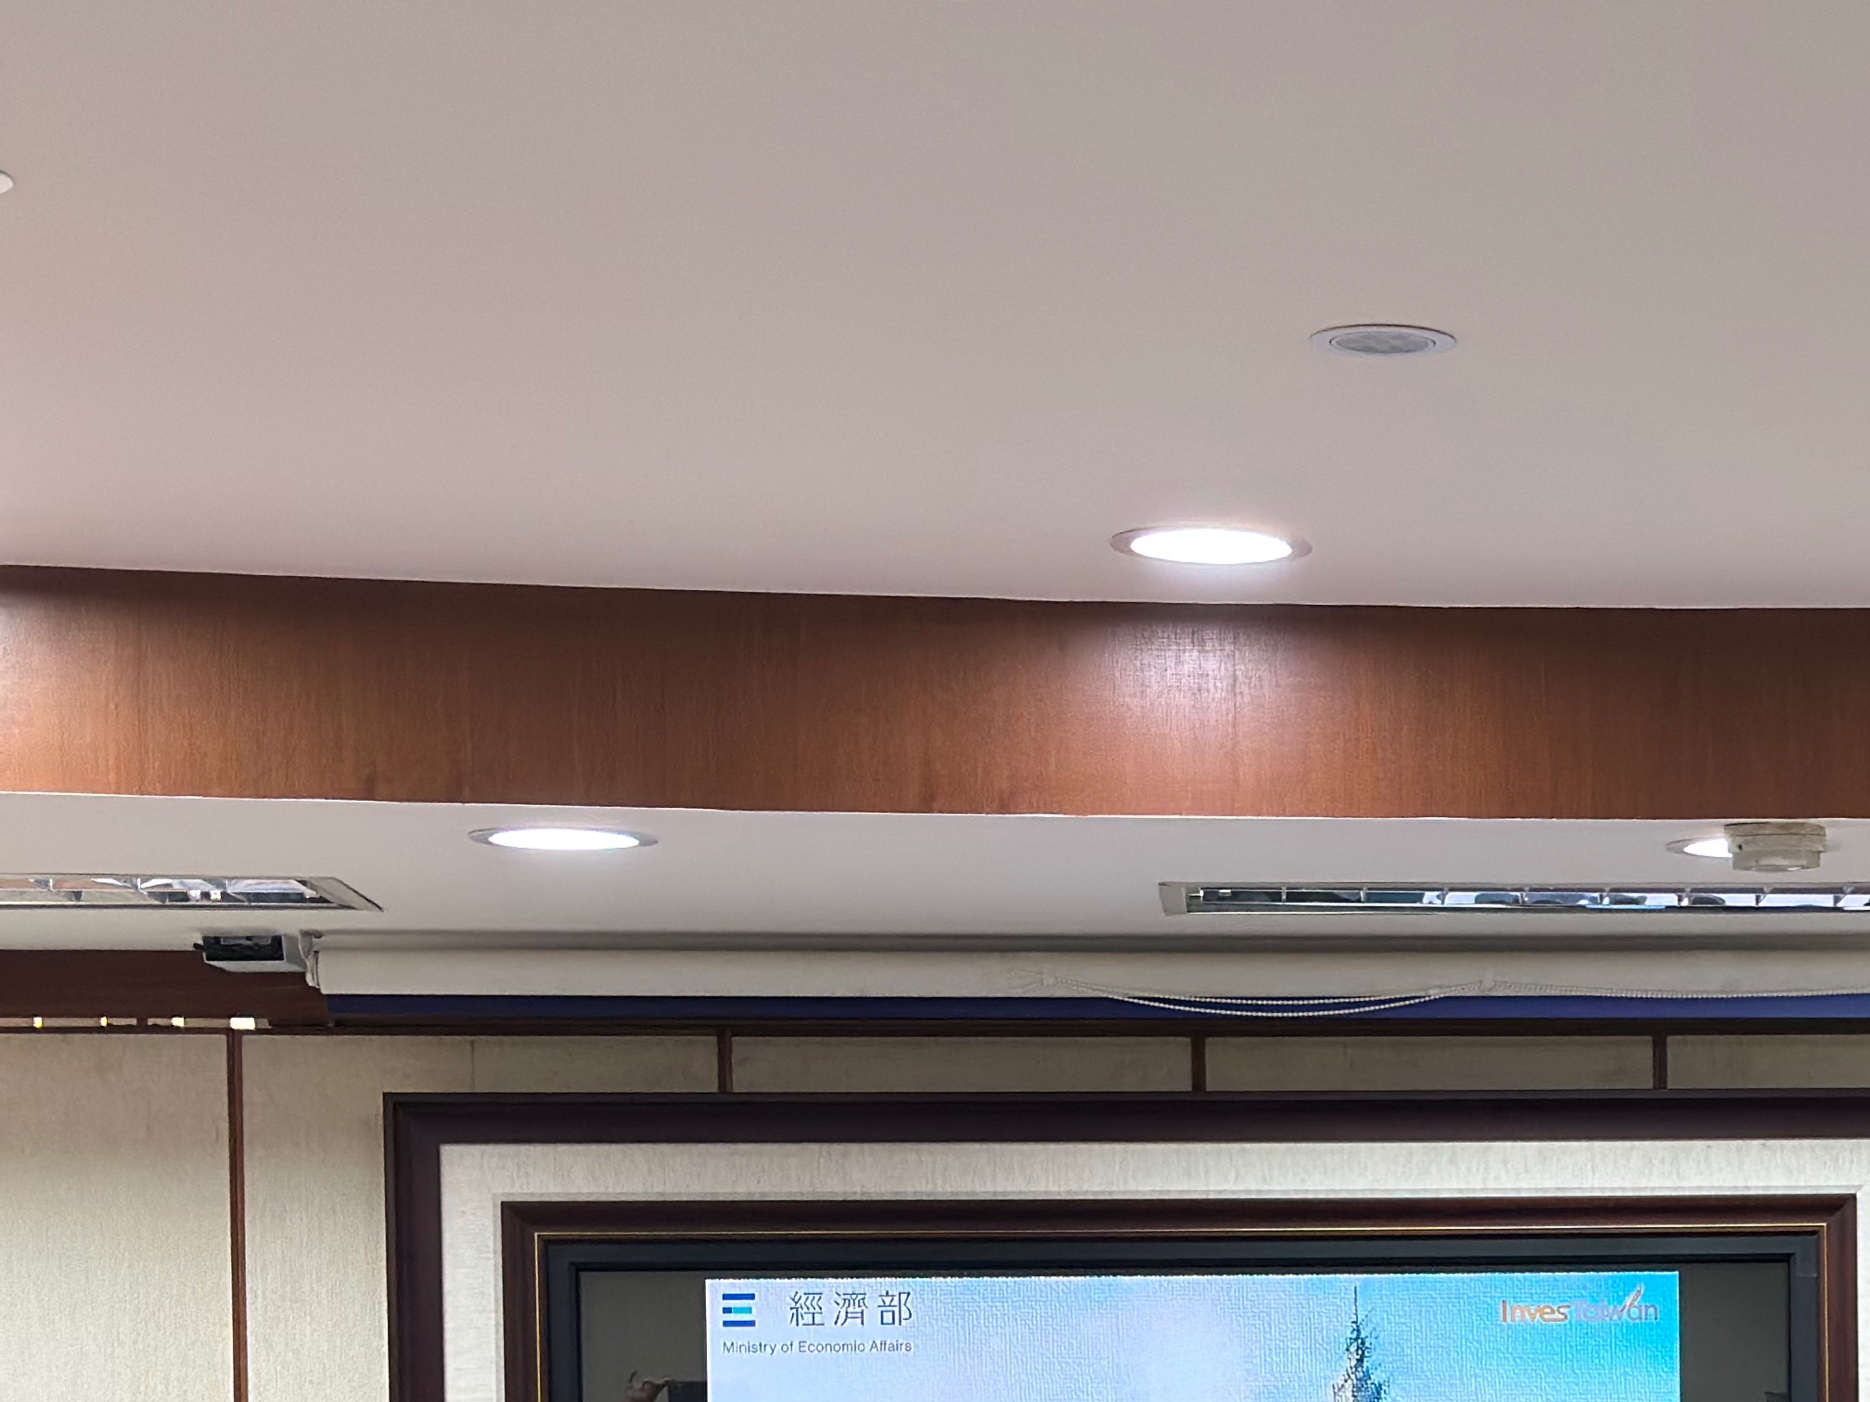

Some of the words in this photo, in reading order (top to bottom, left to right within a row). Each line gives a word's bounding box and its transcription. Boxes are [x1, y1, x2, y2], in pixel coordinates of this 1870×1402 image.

[789, 1290, 913, 1327] 經濟部
[722, 1341, 777, 1355] Ministry
[781, 1340, 794, 1353] of
[798, 1340, 866, 1353] Economic
[869, 1339, 912, 1353] Affairs
